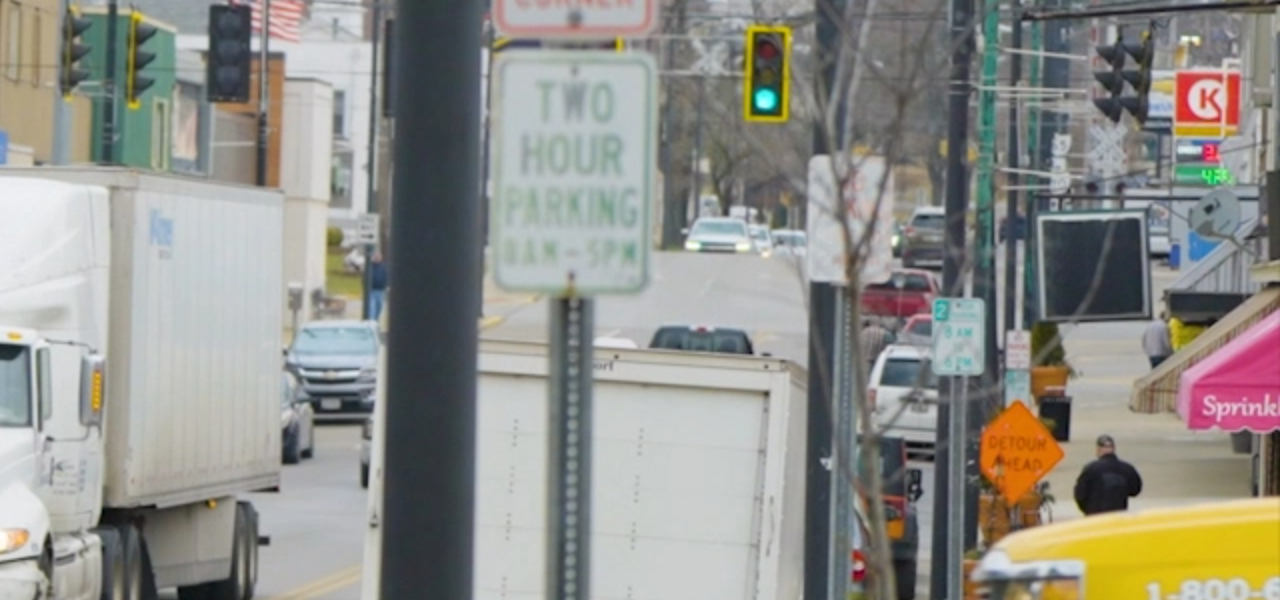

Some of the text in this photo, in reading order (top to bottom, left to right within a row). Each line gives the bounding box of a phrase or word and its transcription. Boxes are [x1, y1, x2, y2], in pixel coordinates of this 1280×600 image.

[536, 80, 614, 125] TWO
[520, 132, 624, 176] HOUR
[504, 185, 638, 228] PARKING
[988, 434, 1048, 452] DETOUR
